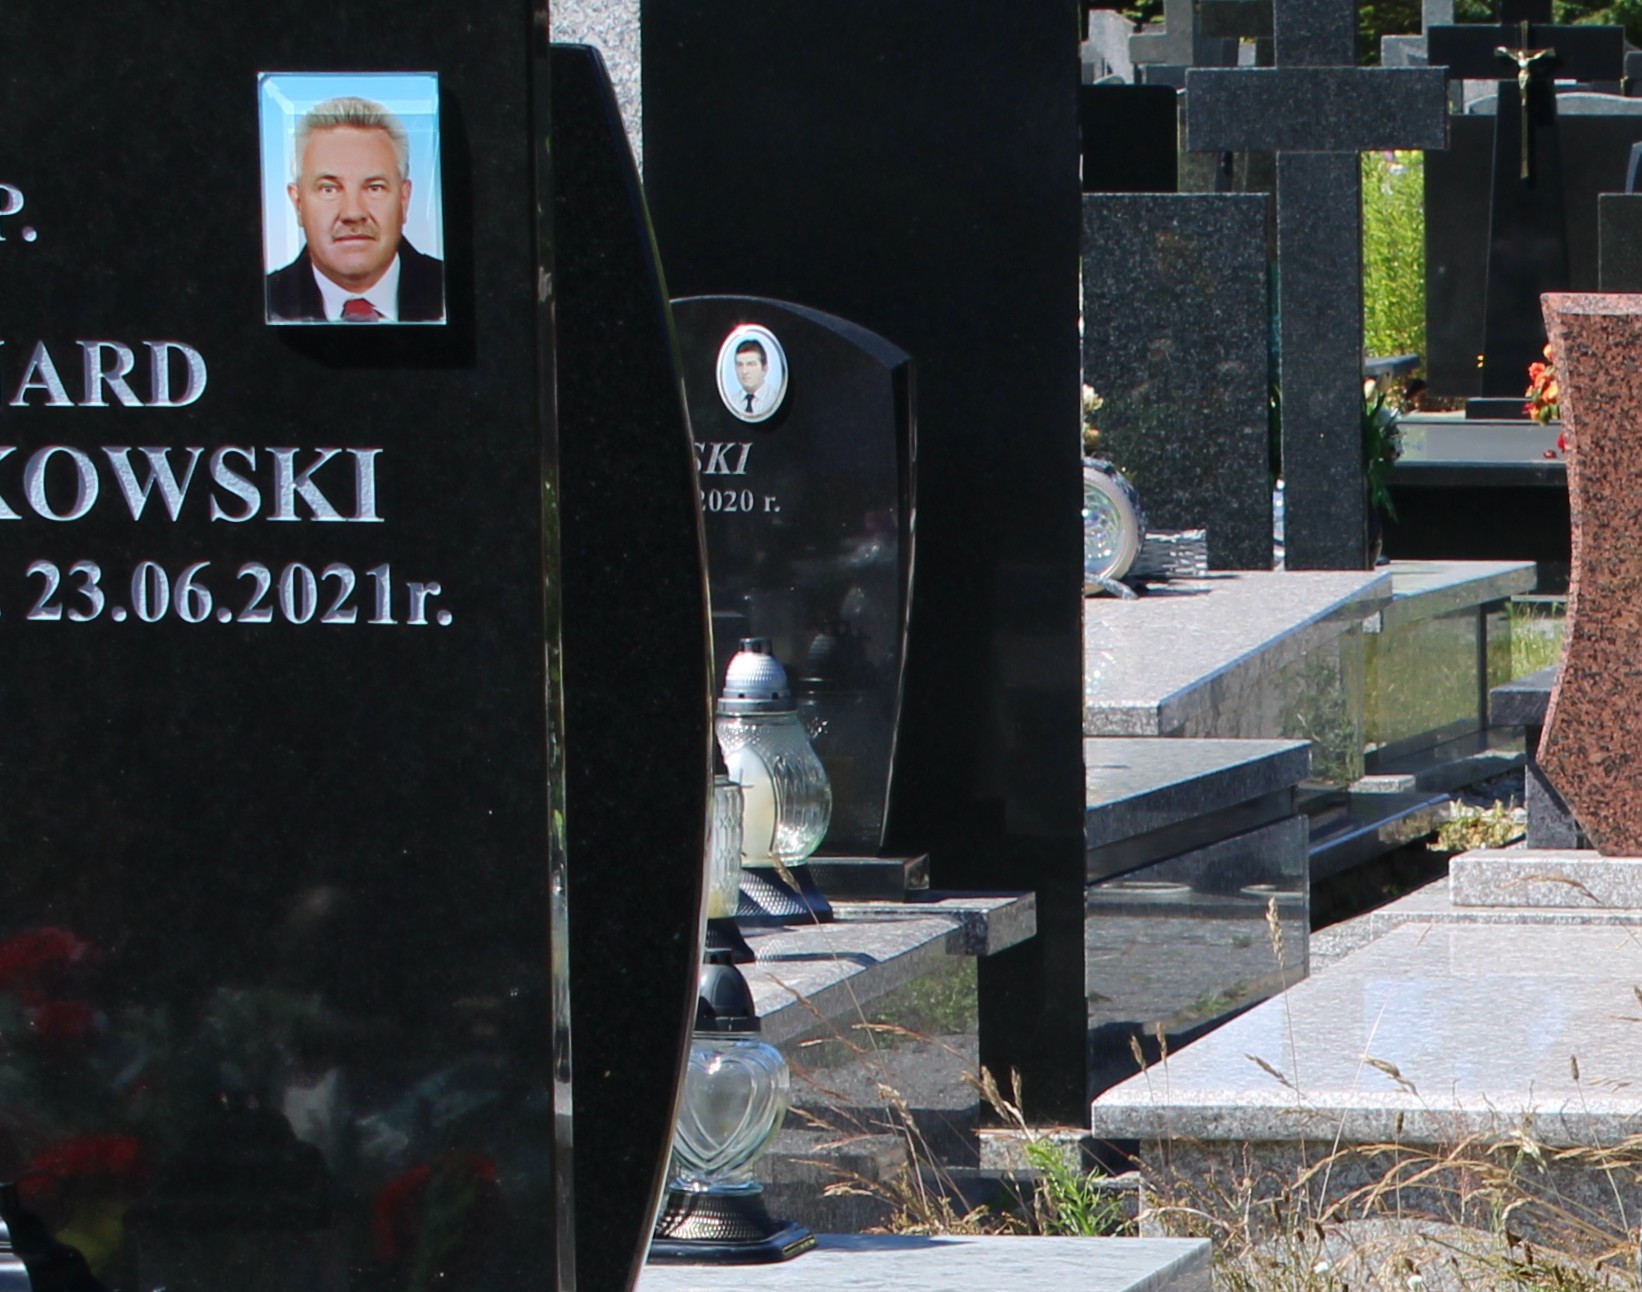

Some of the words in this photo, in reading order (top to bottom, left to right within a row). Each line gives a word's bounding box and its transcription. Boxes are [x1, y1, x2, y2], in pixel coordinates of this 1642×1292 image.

[0, 340, 208, 408] ARD
[0, 445, 385, 523] OWSKI
[763, 496, 780, 512] r.
[25, 558, 454, 627] 23.06.2021r.
